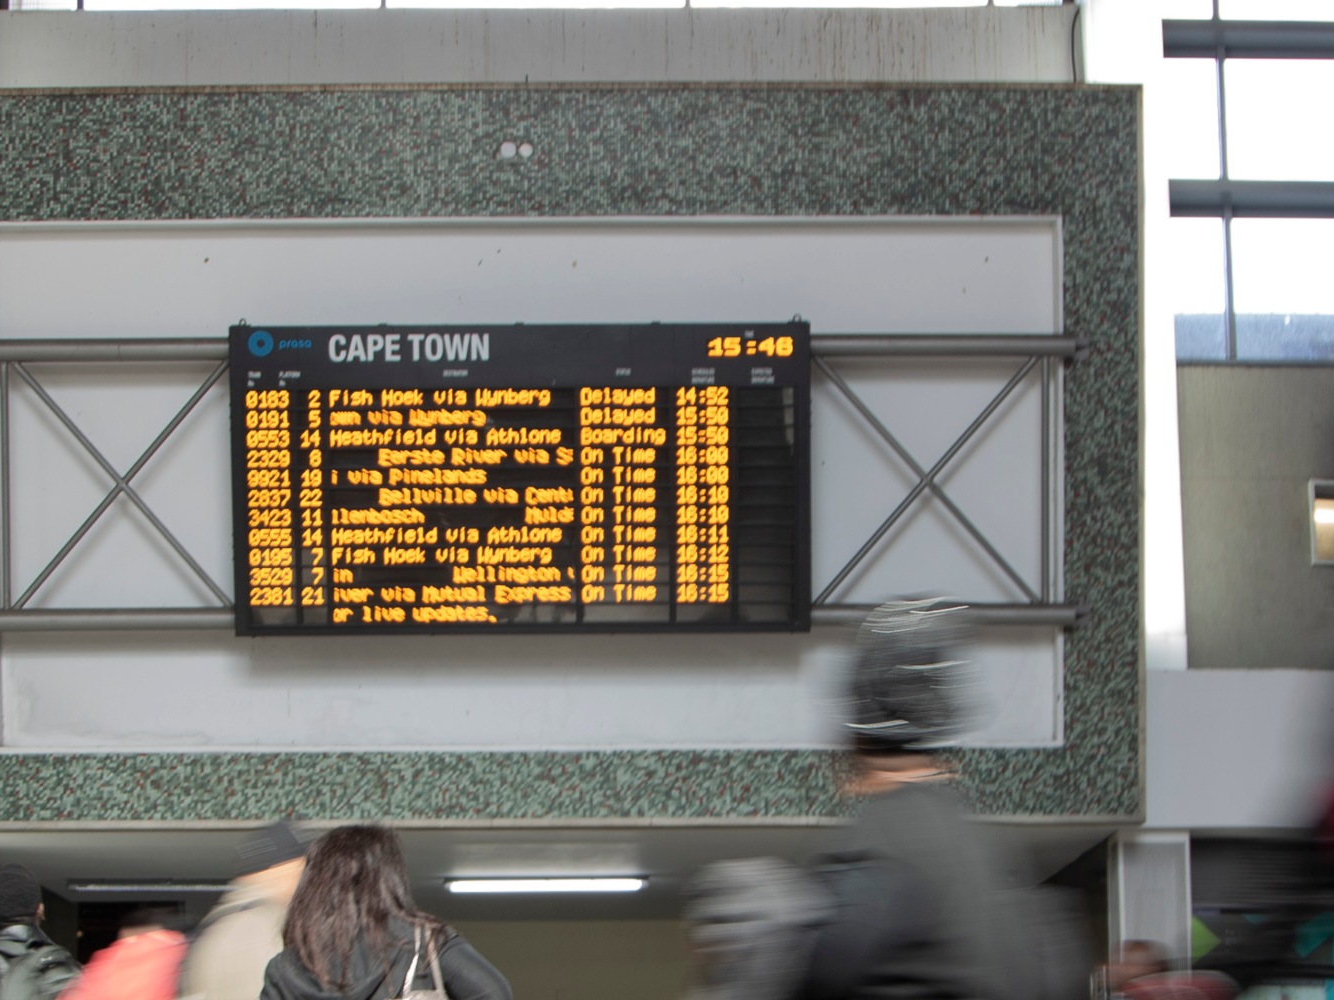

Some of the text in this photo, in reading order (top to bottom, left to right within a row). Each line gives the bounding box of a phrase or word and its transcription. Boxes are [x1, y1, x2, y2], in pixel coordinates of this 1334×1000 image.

[279, 339, 312, 350] prasa
[328, 333, 490, 363] CAPE TOWN
[308, 390, 320, 408] 2
[329, 390, 373, 407] Fish
[381, 389, 423, 407] Hoek
[434, 389, 466, 405] via
[476, 388, 550, 406] Wynberg
[580, 387, 655, 406] Delayed
[677, 387, 728, 405] 14:52
[246, 410, 289, 428] 0191
[309, 410, 321, 428] 5
[368, 409, 402, 425] via
[409, 409, 486, 427] Wynberg
[580, 405, 655, 426] Delayed
[677, 404, 728, 425] 15:50
[247, 424, 728, 448] 0553 14 Heathfield via Athlone Boarding 15:50
[247, 450, 290, 468] 2329
[451, 448, 507, 465] River
[514, 448, 549, 464] via
[581, 447, 603, 465] On
[613, 447, 655, 465] Time
[677, 444, 728, 464] 16:00
[348, 469, 382, 485] via
[389, 468, 486, 485] Pinelands
[581, 467, 603, 485] On
[613, 466, 655, 484] Time
[677, 464, 728, 484] 16:00
[300, 489, 322, 507] 22
[379, 487, 476, 506] Bellville
[483, 487, 518, 504] via
[581, 484, 603, 504] On
[613, 486, 655, 504] Time
[677, 483, 728, 504] 16:10
[249, 509, 291, 527] 3423
[302, 509, 322, 526] 11
[581, 506, 604, 524] On
[613, 506, 655, 524] Time
[677, 503, 729, 524] 16:10
[249, 523, 728, 546] 0555 14 Heathfield via Athlone On Time 16:11
[312, 548, 323, 565] 7
[332, 547, 375, 565] Fish
[384, 547, 425, 564] Hoek
[436, 547, 469, 563] via
[477, 546, 552, 564] Wynberg
[581, 543, 604, 563] On
[613, 545, 656, 563] Time
[677, 542, 728, 563] 16:12
[250, 568, 292, 585] 3529
[312, 567, 324, 584] 7
[334, 568, 353, 582] in
[453, 566, 561, 584] Wellington
[581, 565, 604, 583] On
[613, 564, 656, 583] Time
[677, 562, 728, 583] 16:15
[302, 587, 324, 605] 21
[381, 586, 415, 602] via
[422, 585, 486, 603] Mutual
[495, 585, 571, 603] Express
[582, 584, 604, 603] On
[613, 584, 656, 602] Time
[677, 582, 728, 602] 16:15
[363, 606, 405, 622] live
[413, 605, 496, 622] updates.
